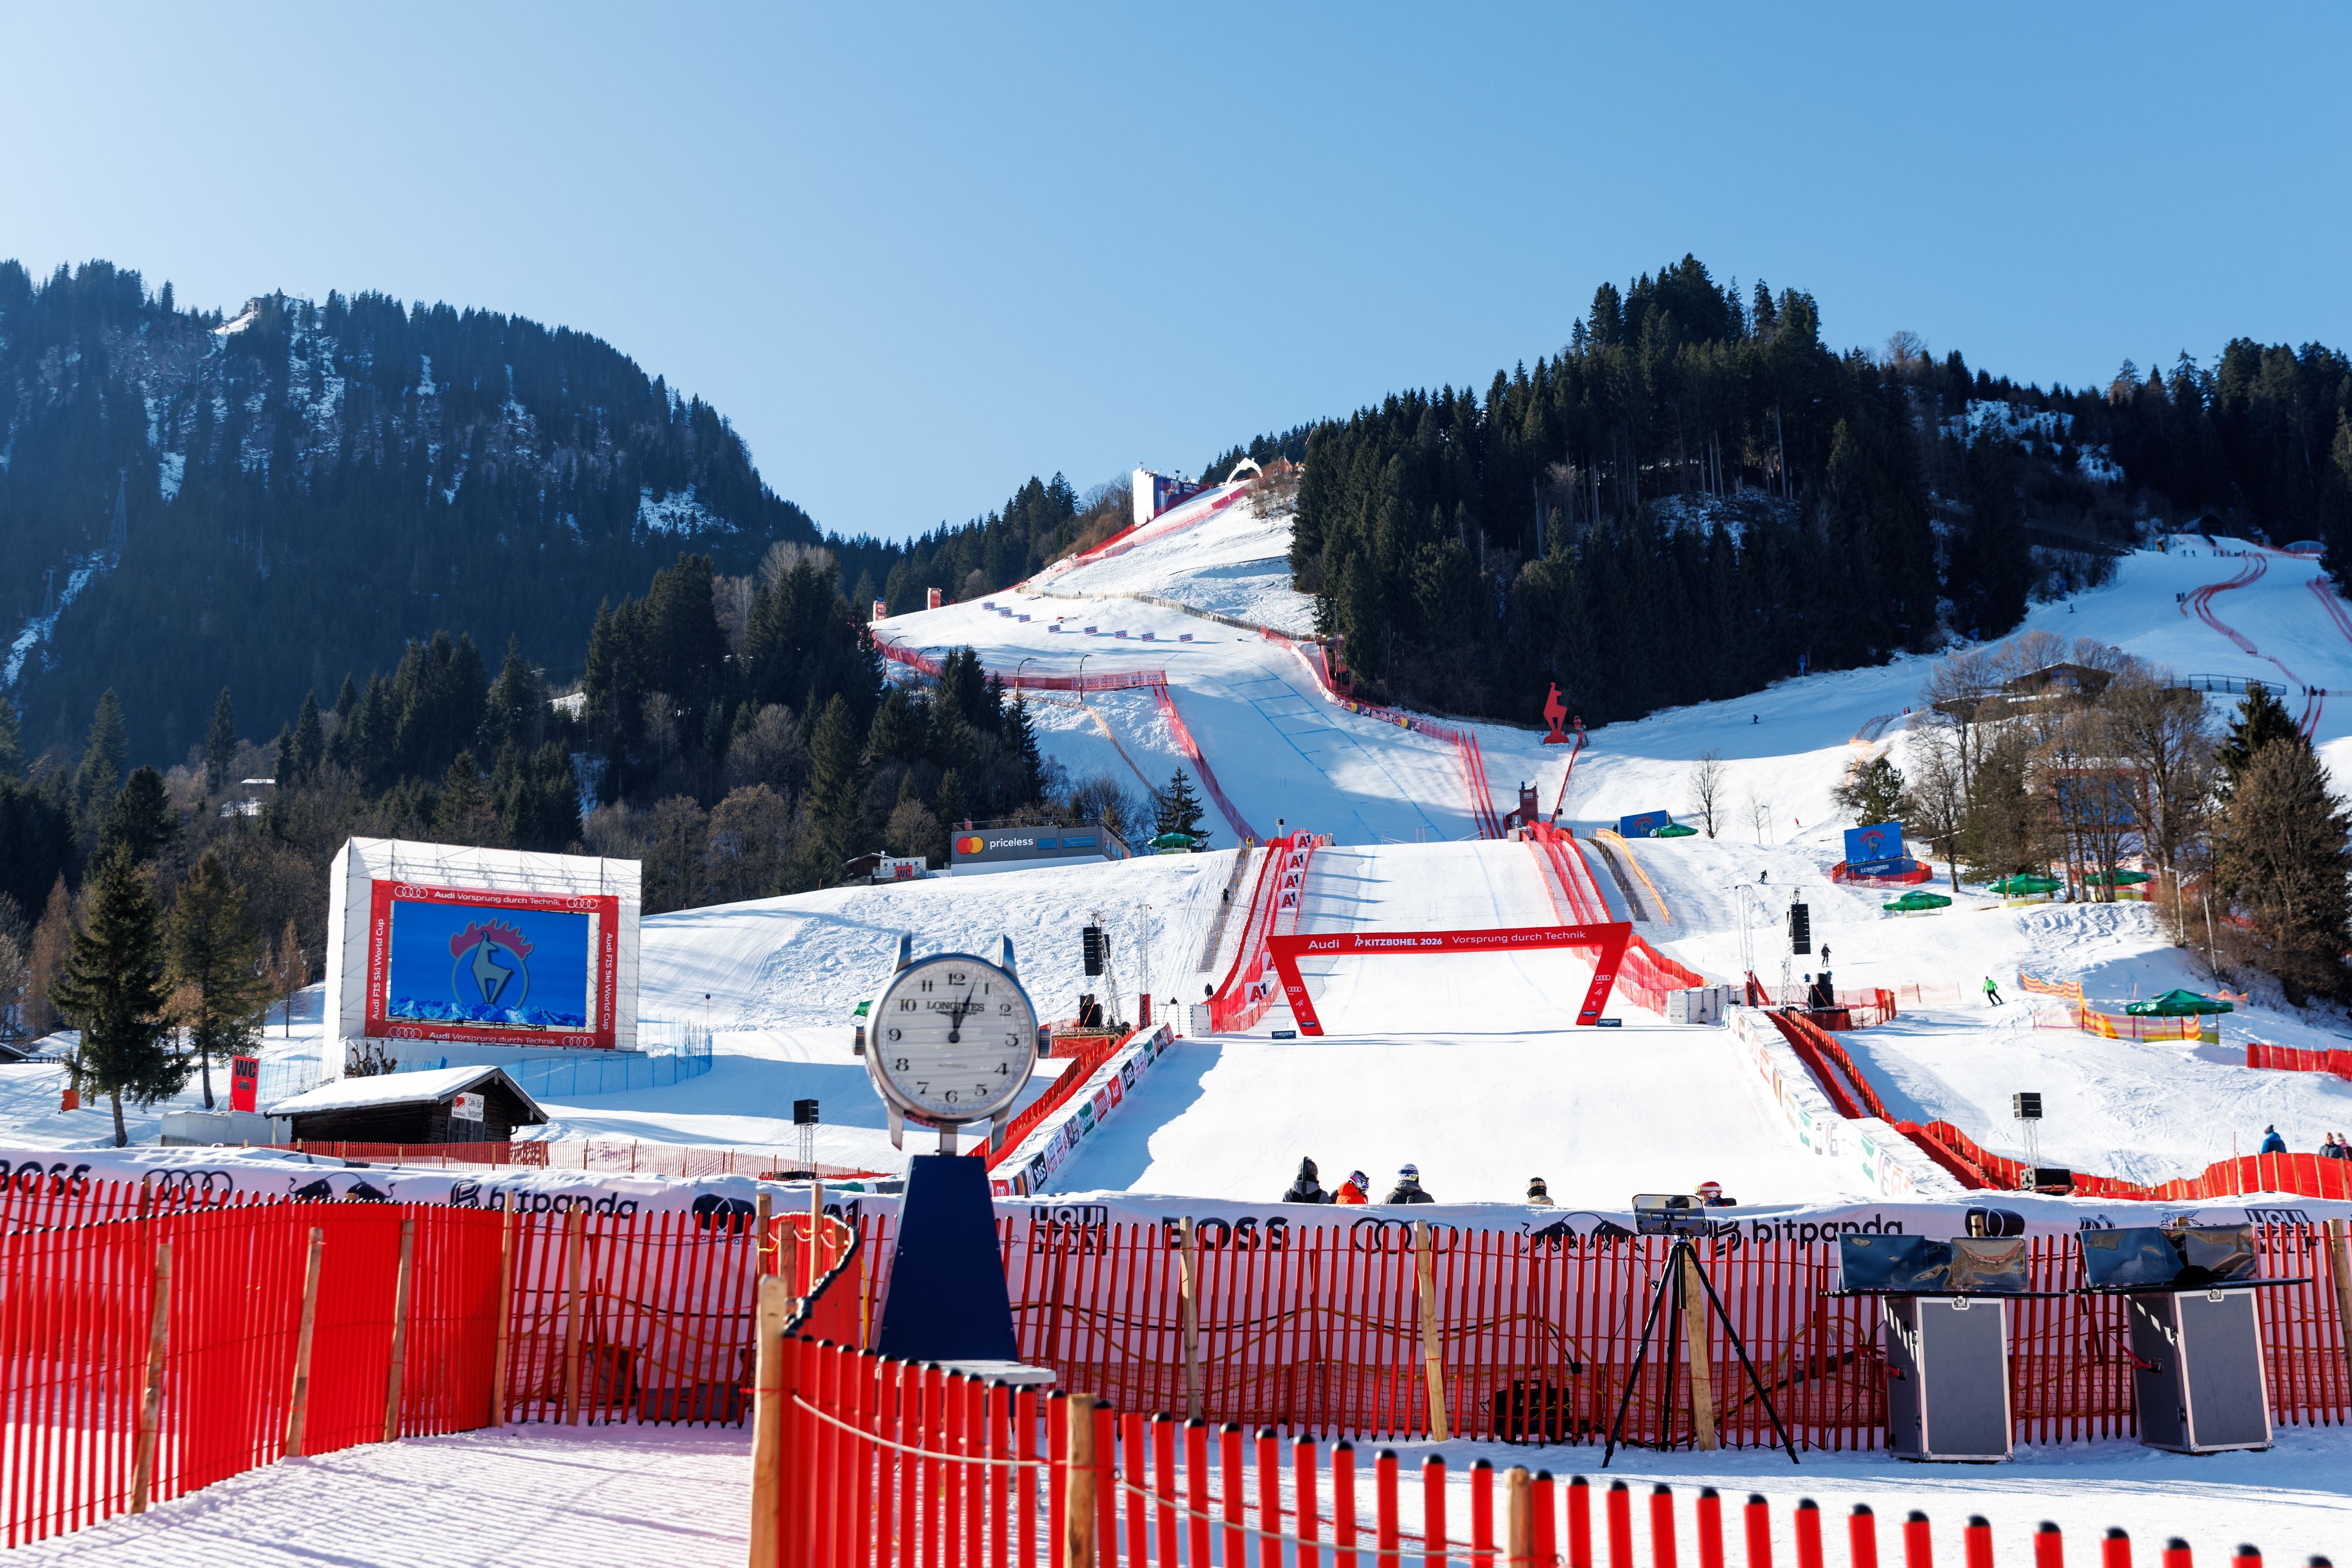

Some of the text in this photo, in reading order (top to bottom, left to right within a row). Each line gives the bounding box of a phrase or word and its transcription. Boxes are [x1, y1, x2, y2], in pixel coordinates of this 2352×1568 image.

[990, 837, 1034, 850] priceless
[1298, 834, 1311, 848] A1
[1289, 854, 1303, 868] A1
[897, 869, 910, 878] WC
[1860, 864, 1889, 873] LONGINES
[1284, 874, 1298, 888] A1
[457, 893, 501, 903] Vorsprung
[1282, 892, 1295, 907] A1
[376, 918, 385, 936] Cup
[1308, 940, 1339, 950] Audi
[1452, 935, 1508, 944] Vorsprung
[1511, 933, 1542, 941] durch
[1544, 931, 1586, 940] Technik
[948, 973, 965, 985] 12
[921, 980, 933, 992] 11
[984, 982, 989, 994] 1
[1250, 982, 1267, 1002] A1
[900, 999, 917, 1011] 10
[1000, 1004, 1011, 1016] 2
[452, 1034, 496, 1043] Vorsprung
[889, 1028, 901, 1041] 9
[1005, 1034, 1019, 1047] 3
[236, 1059, 256, 1078] WC
[896, 1058, 909, 1071] 8
[994, 1063, 1009, 1075] 4
[917, 1081, 929, 1094] 7
[975, 1084, 987, 1096] 5
[946, 1090, 958, 1103] 6
[1035, 1206, 1104, 1228] LIQUI
